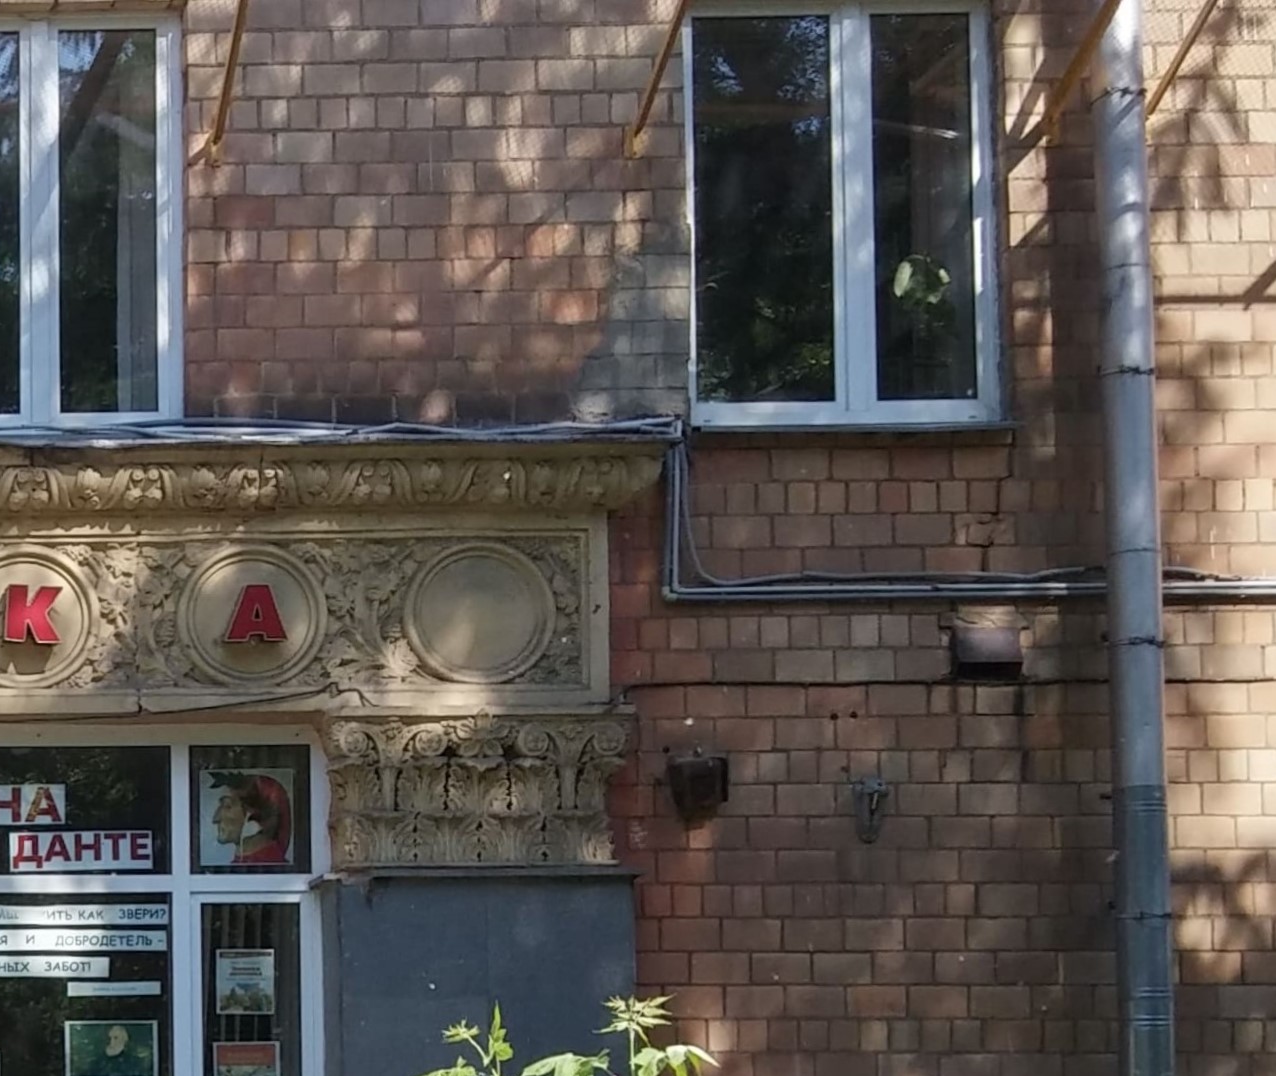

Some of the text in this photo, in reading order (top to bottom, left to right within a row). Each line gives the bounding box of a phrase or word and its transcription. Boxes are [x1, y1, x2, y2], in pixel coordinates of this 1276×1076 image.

[13, 832, 152, 869] ДАНТЕ
[38, 908, 73, 921] ИТЬ
[78, 909, 104, 921] КАК
[118, 908, 166, 920] ЗВЕРИ?
[25, 934, 36, 945] И
[55, 934, 153, 947] ДОБРОДЕТЕЛЬ
[44, 960, 91, 973] ЗАБОТ!
